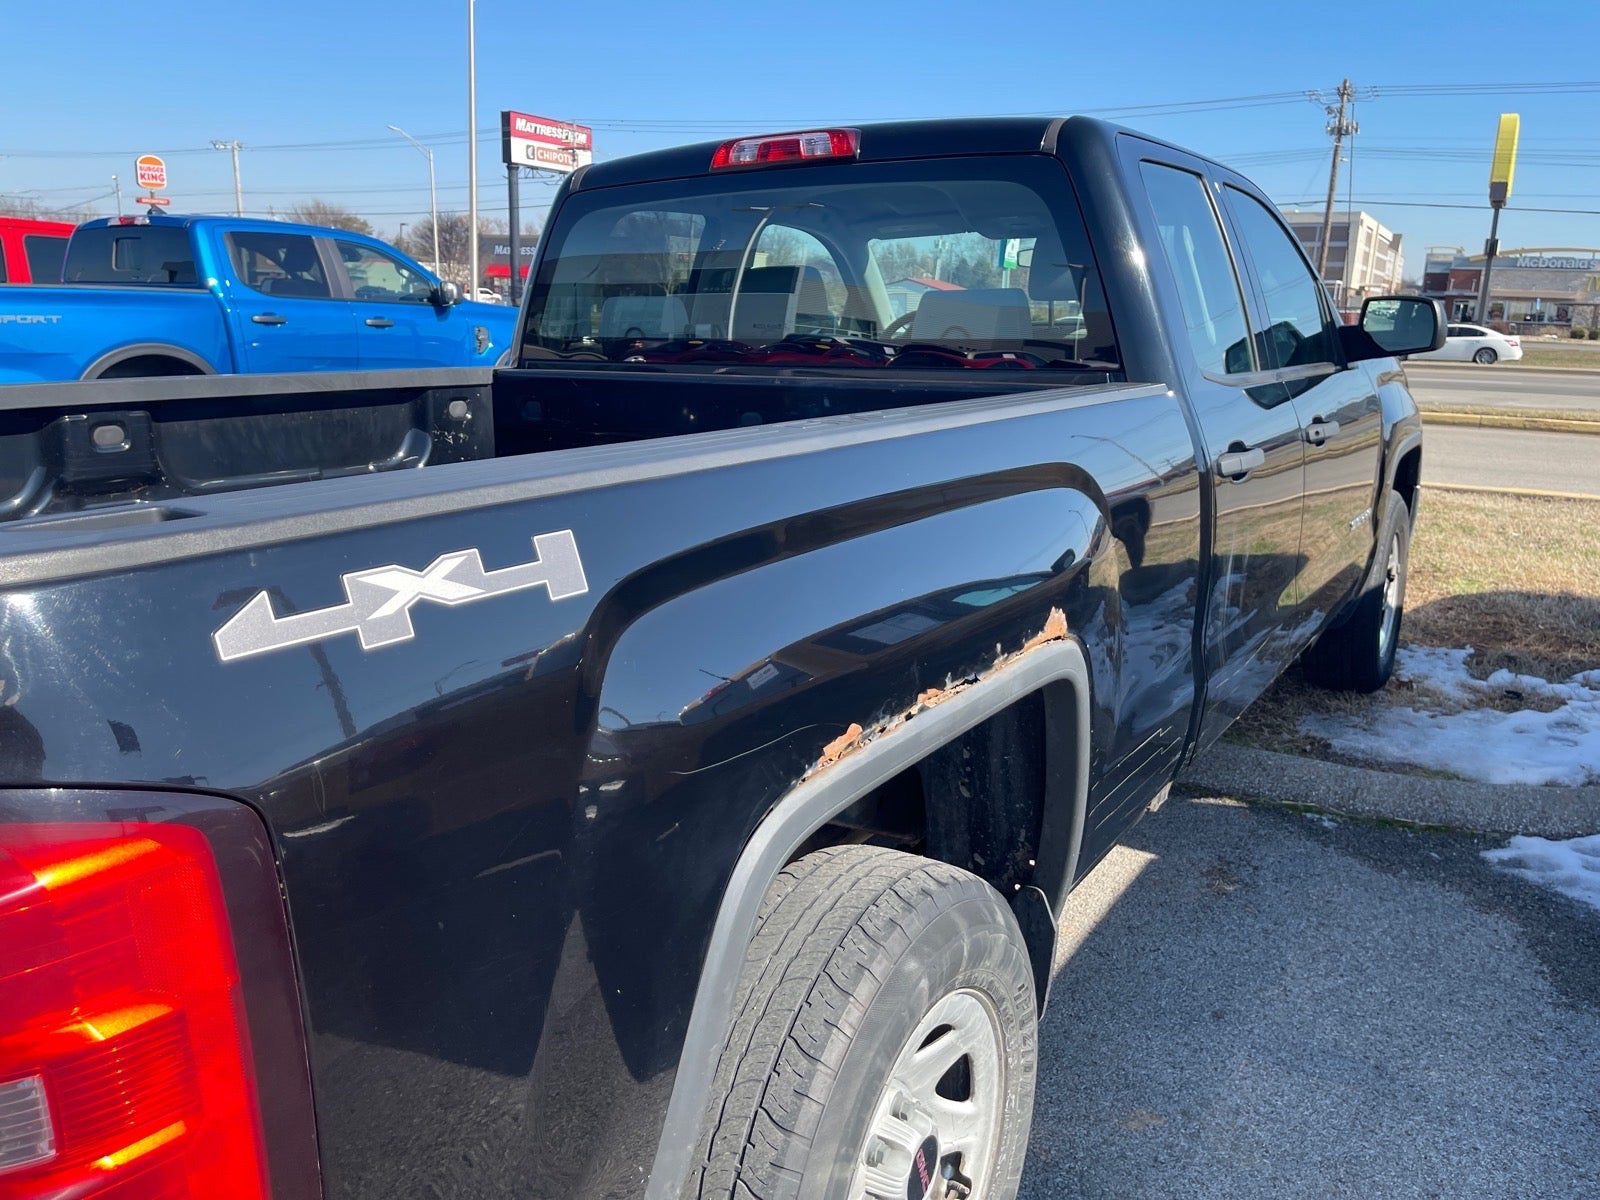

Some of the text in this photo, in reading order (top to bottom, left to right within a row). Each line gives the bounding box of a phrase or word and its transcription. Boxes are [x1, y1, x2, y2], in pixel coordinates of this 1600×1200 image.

[537, 149, 577, 166] CHIPOTL
[140, 173, 165, 182] KING
[494, 245, 537, 255] MATESS
[1516, 256, 1597, 268] McDonalds
[0, 315, 62, 324] PORT
